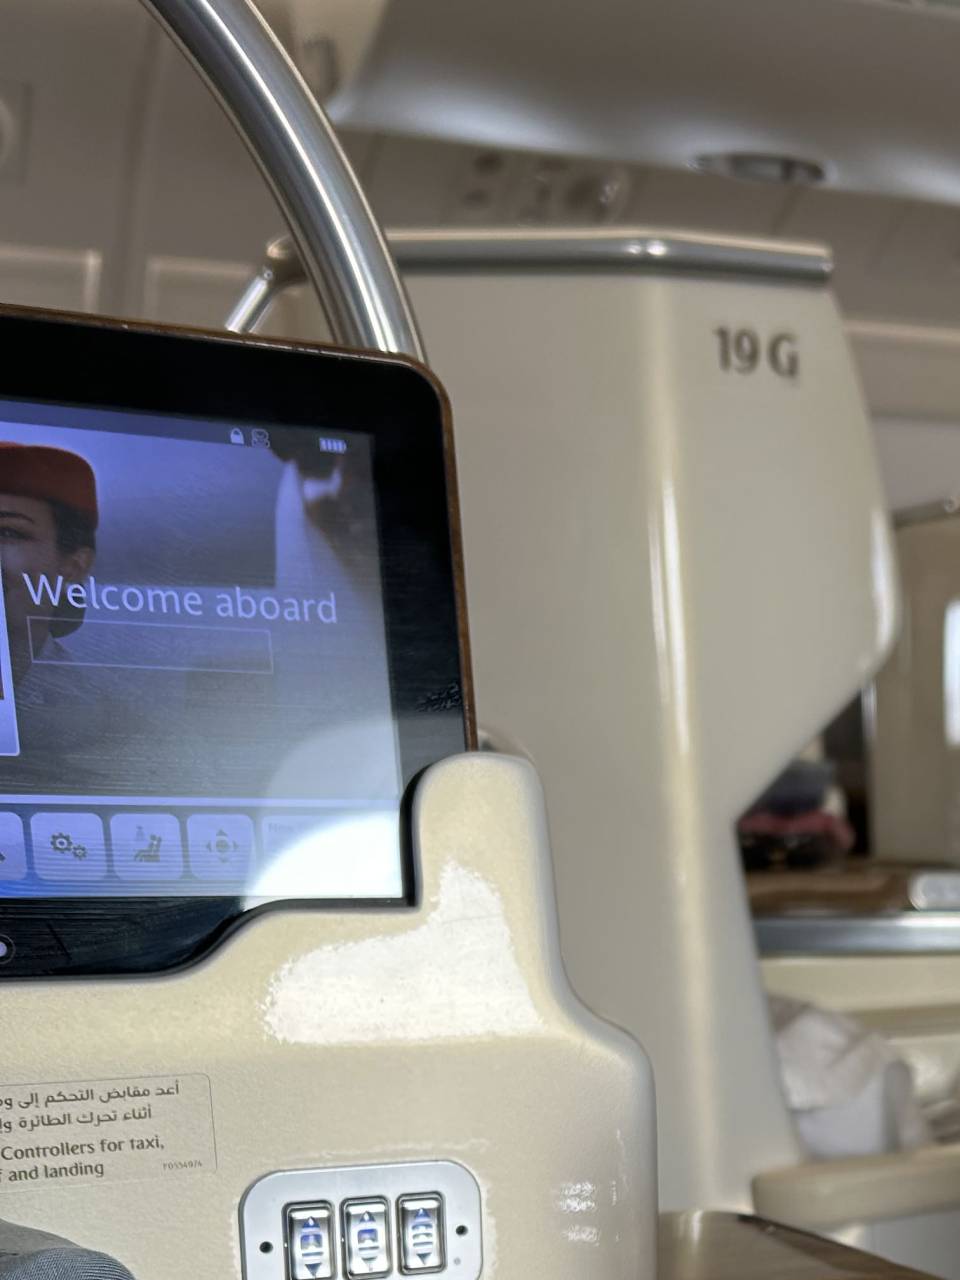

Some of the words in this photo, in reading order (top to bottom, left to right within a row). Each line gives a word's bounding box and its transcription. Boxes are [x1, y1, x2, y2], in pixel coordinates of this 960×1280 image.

[23, 572, 203, 616] Welcome
[216, 587, 338, 623] aboard
[99, 1086, 151, 1104] مقابض
[155, 1080, 180, 1097] أعد
[18, 1093, 39, 1109] إلى
[44, 1089, 94, 1108] التحكم
[76, 1110, 118, 1127] تحرك
[122, 1104, 153, 1121] أثناء
[19, 1113, 71, 1132] الطائرة
[1, 1140, 95, 1161] Controllers
[100, 1138, 125, 1153] for
[130, 1135, 165, 1151] taxi,
[8, 1166, 39, 1182] and
[44, 1162, 105, 1179] landing
